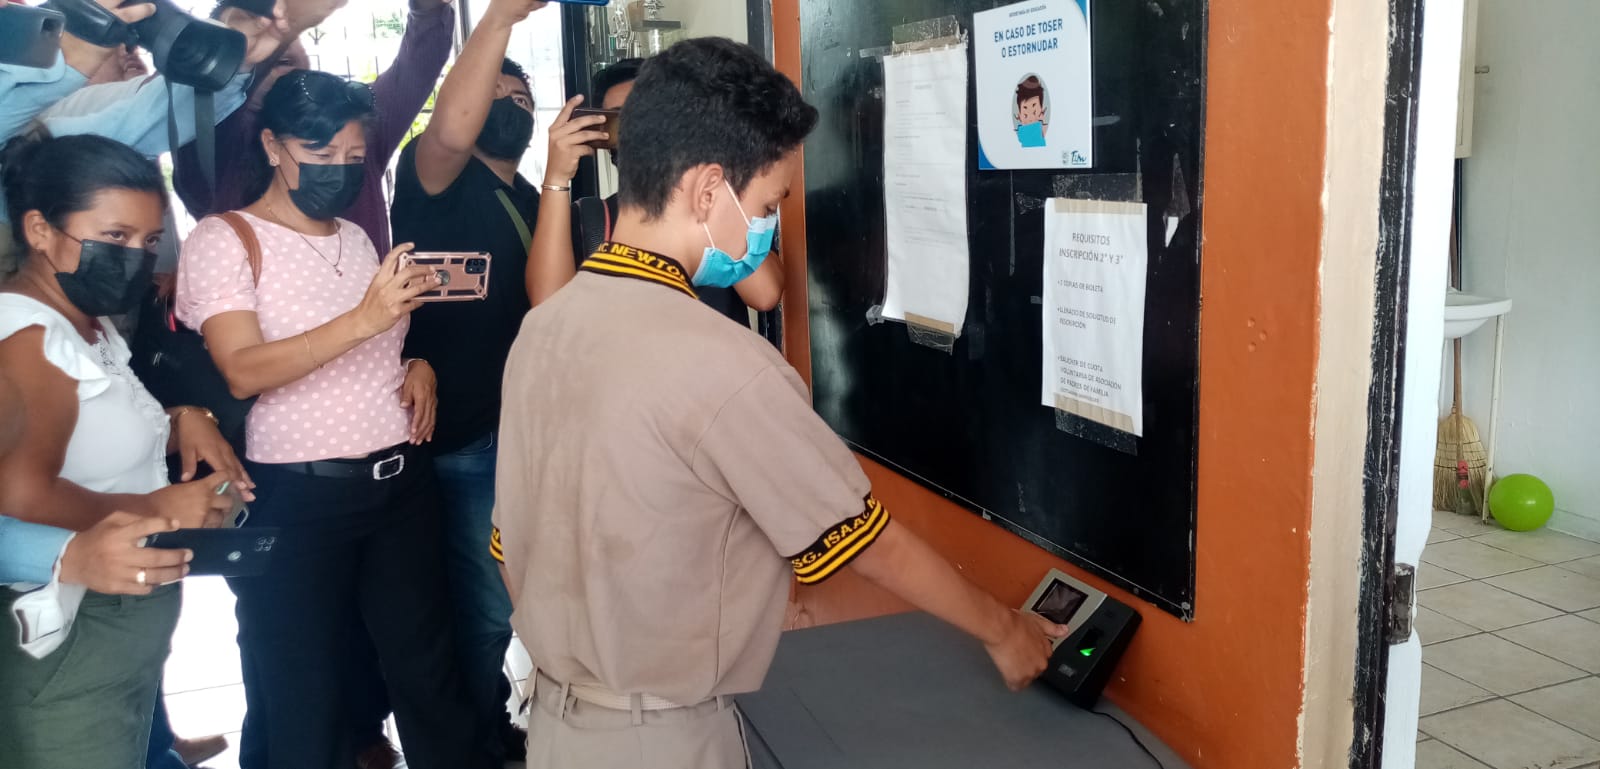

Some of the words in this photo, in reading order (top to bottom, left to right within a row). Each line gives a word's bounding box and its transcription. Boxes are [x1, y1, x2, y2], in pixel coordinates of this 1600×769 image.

[994, 31, 1004, 42] EN
[1005, 26, 1024, 40] CASO
[1026, 24, 1037, 37] DE
[1038, 18, 1063, 34] TOSER
[1001, 47, 1007, 58] O
[1008, 37, 1058, 57] ESTORNUDAR
[1072, 232, 1111, 246] REQUISITOS
[1059, 247, 1099, 262] INSCRIPCIÓN
[1109, 254, 1114, 264] Y
[823, 510, 870, 549] ISAAC
